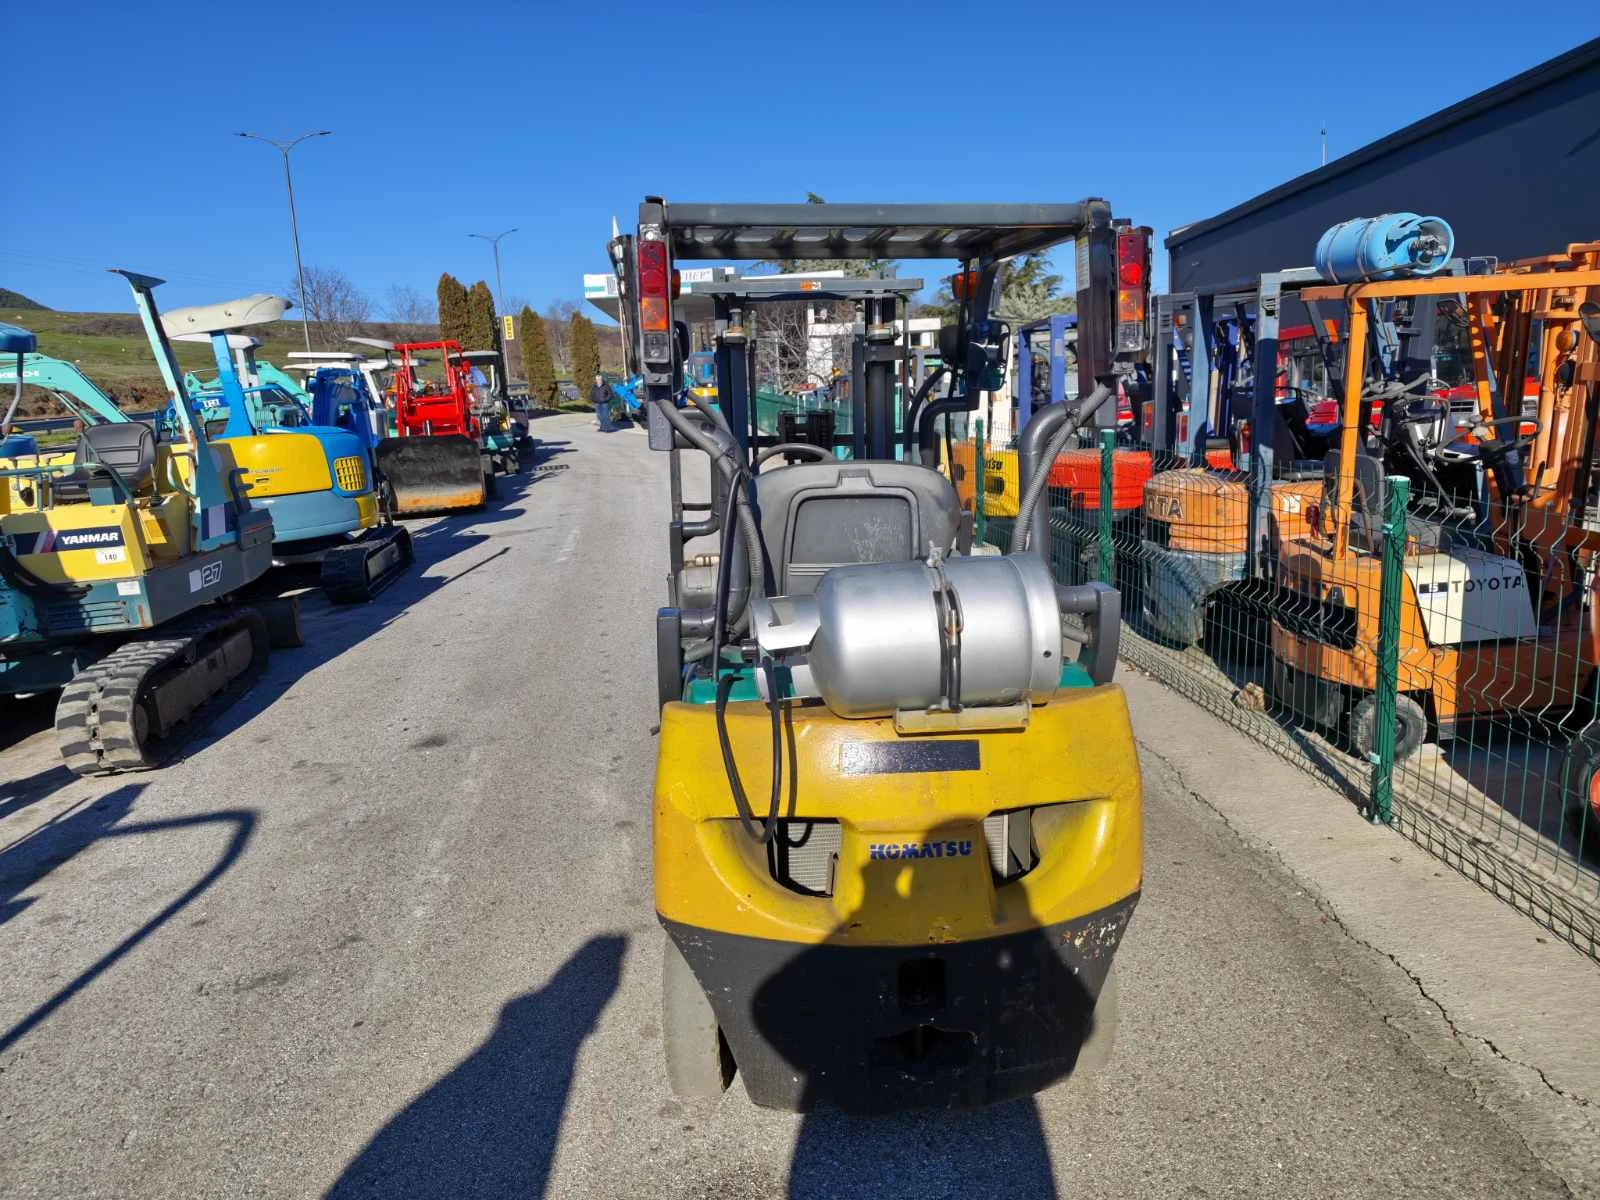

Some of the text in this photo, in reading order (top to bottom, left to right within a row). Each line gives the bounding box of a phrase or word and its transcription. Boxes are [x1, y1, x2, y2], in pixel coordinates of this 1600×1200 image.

[61, 532, 119, 545] YANMAR
[202, 561, 222, 587] 27
[1451, 576, 1524, 593] TOYOTA
[869, 840, 972, 859] KOMATSU
